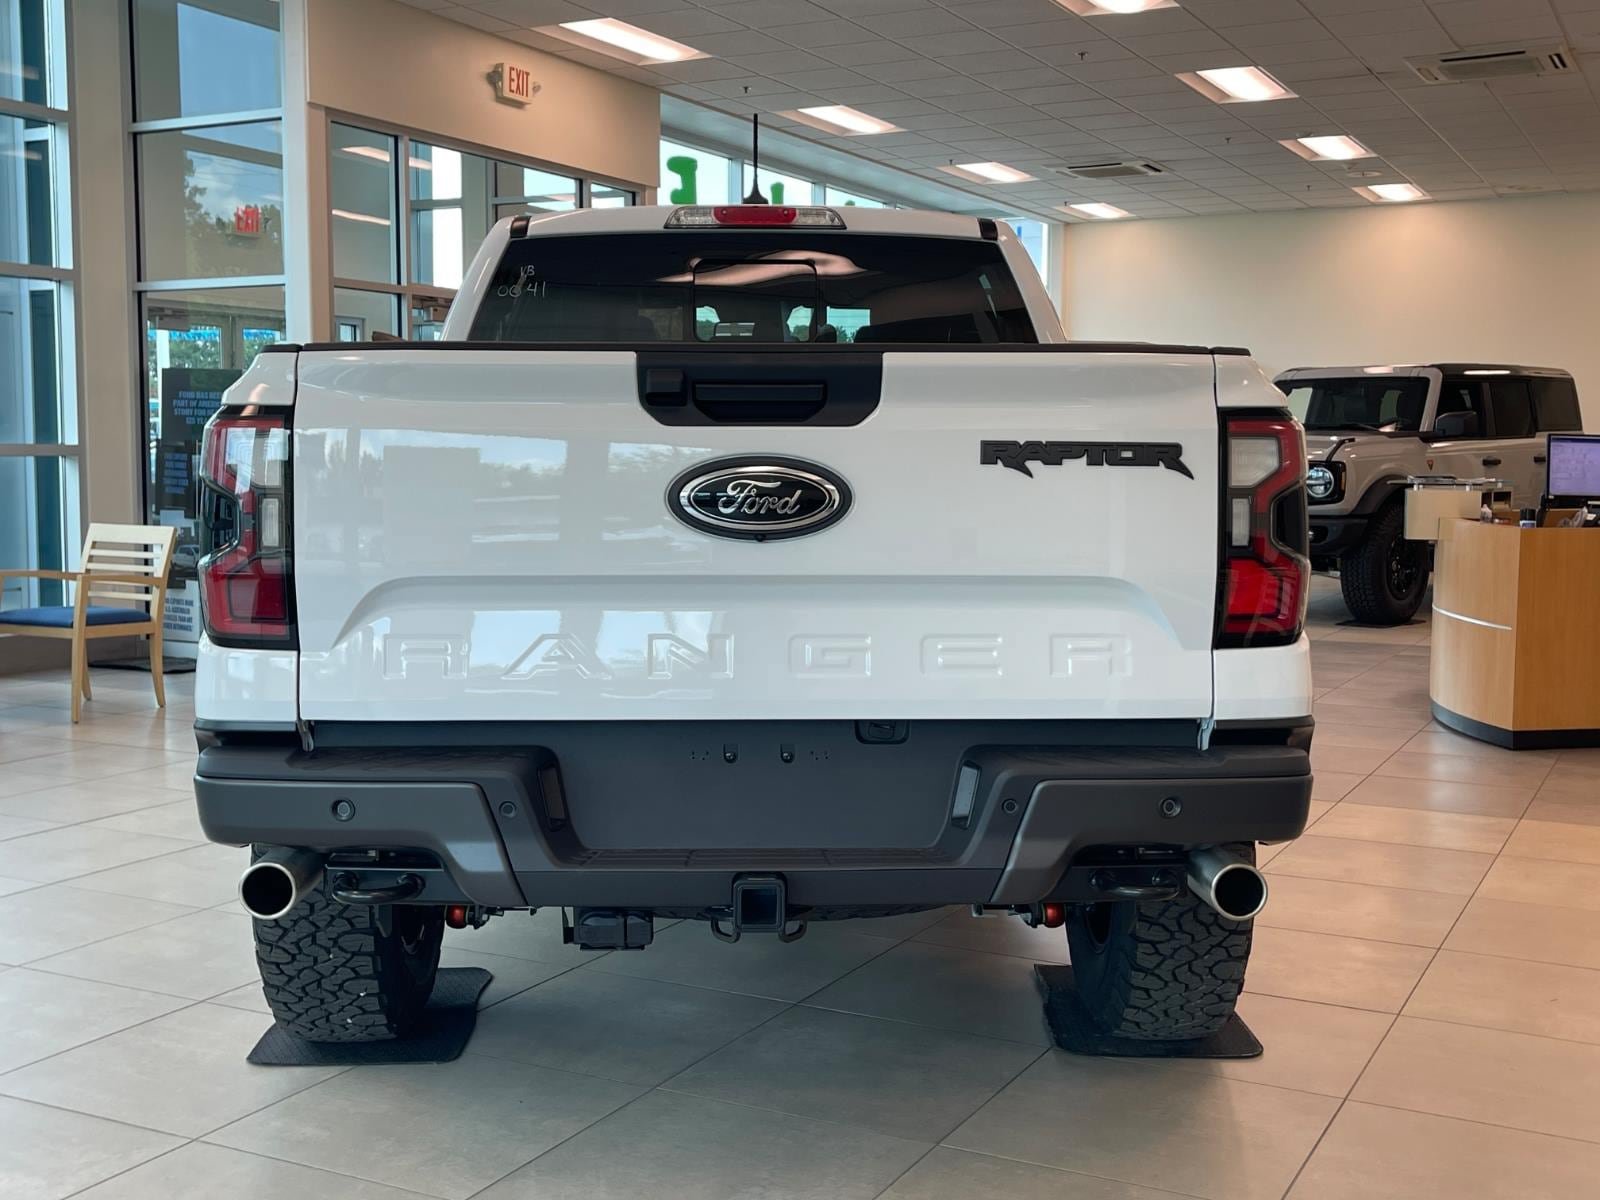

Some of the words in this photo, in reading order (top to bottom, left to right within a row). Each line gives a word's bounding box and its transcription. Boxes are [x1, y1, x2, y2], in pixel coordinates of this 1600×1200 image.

[508, 66, 530, 98] EXIT
[980, 440, 1194, 480] RAPTOR
[718, 479, 802, 515] Ford
[383, 633, 1133, 680] RANGER
